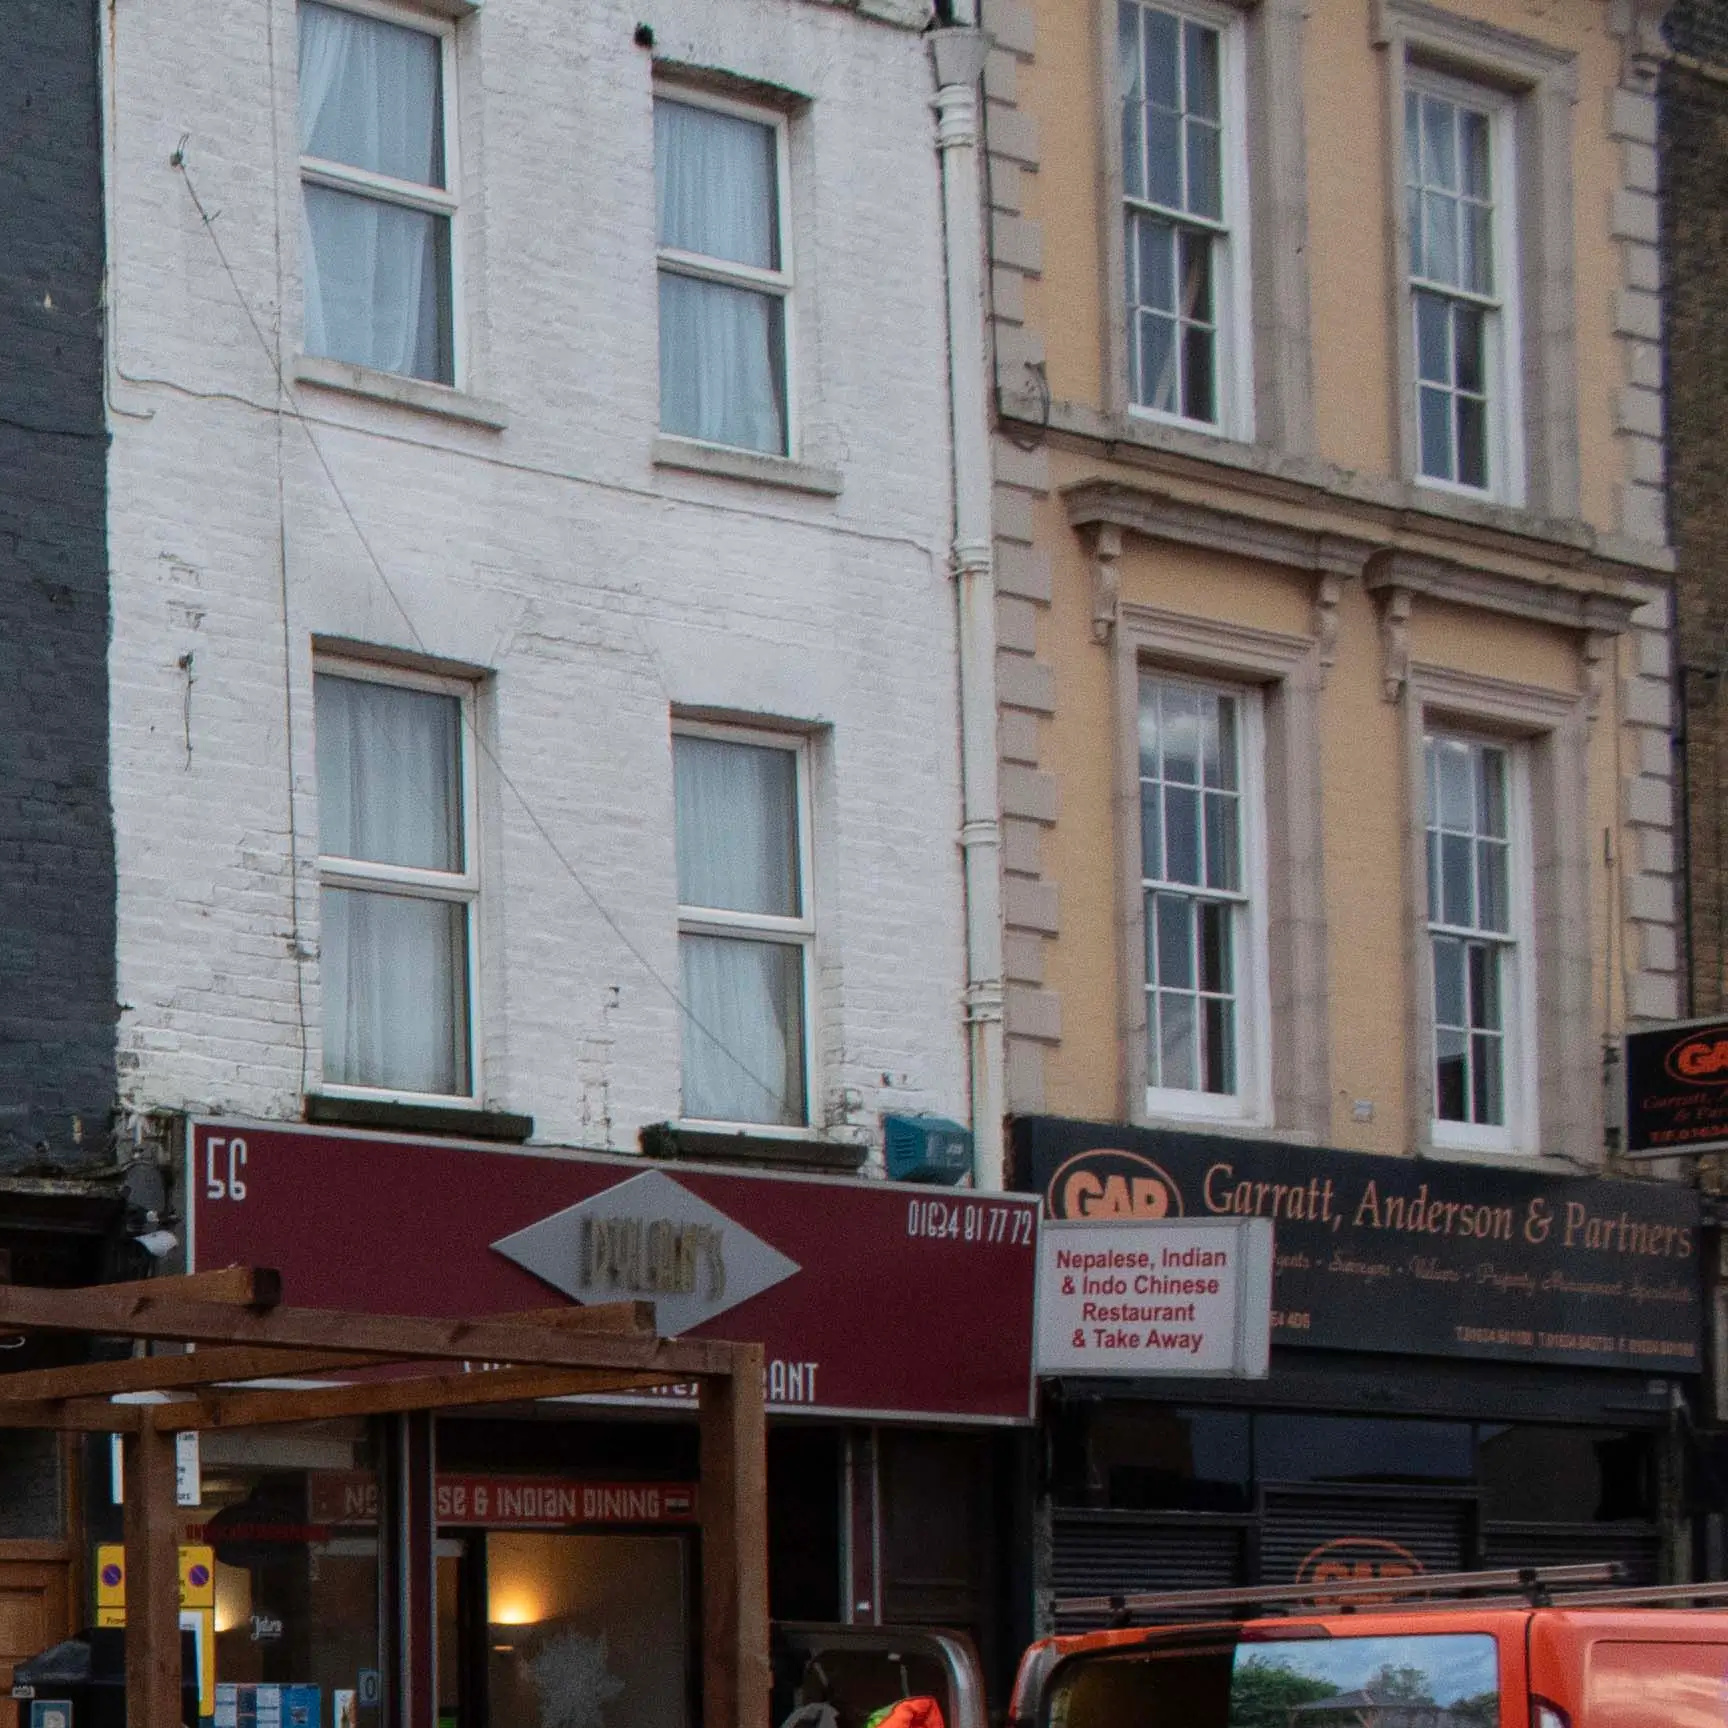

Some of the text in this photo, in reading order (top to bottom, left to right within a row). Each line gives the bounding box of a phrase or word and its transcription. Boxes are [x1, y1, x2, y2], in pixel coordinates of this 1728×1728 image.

[205, 1136, 247, 1201] 56
[1203, 1162, 1694, 1259] Garratt, Anderson & Partners
[1056, 1247, 1227, 1275] Nepalese, Indian
[1061, 1275, 1220, 1296] & Indo Chinese
[1082, 1302, 1196, 1322] Restaurant
[1071, 1328, 1204, 1354] & Take Away
[582, 1487, 661, 1521] DINING
